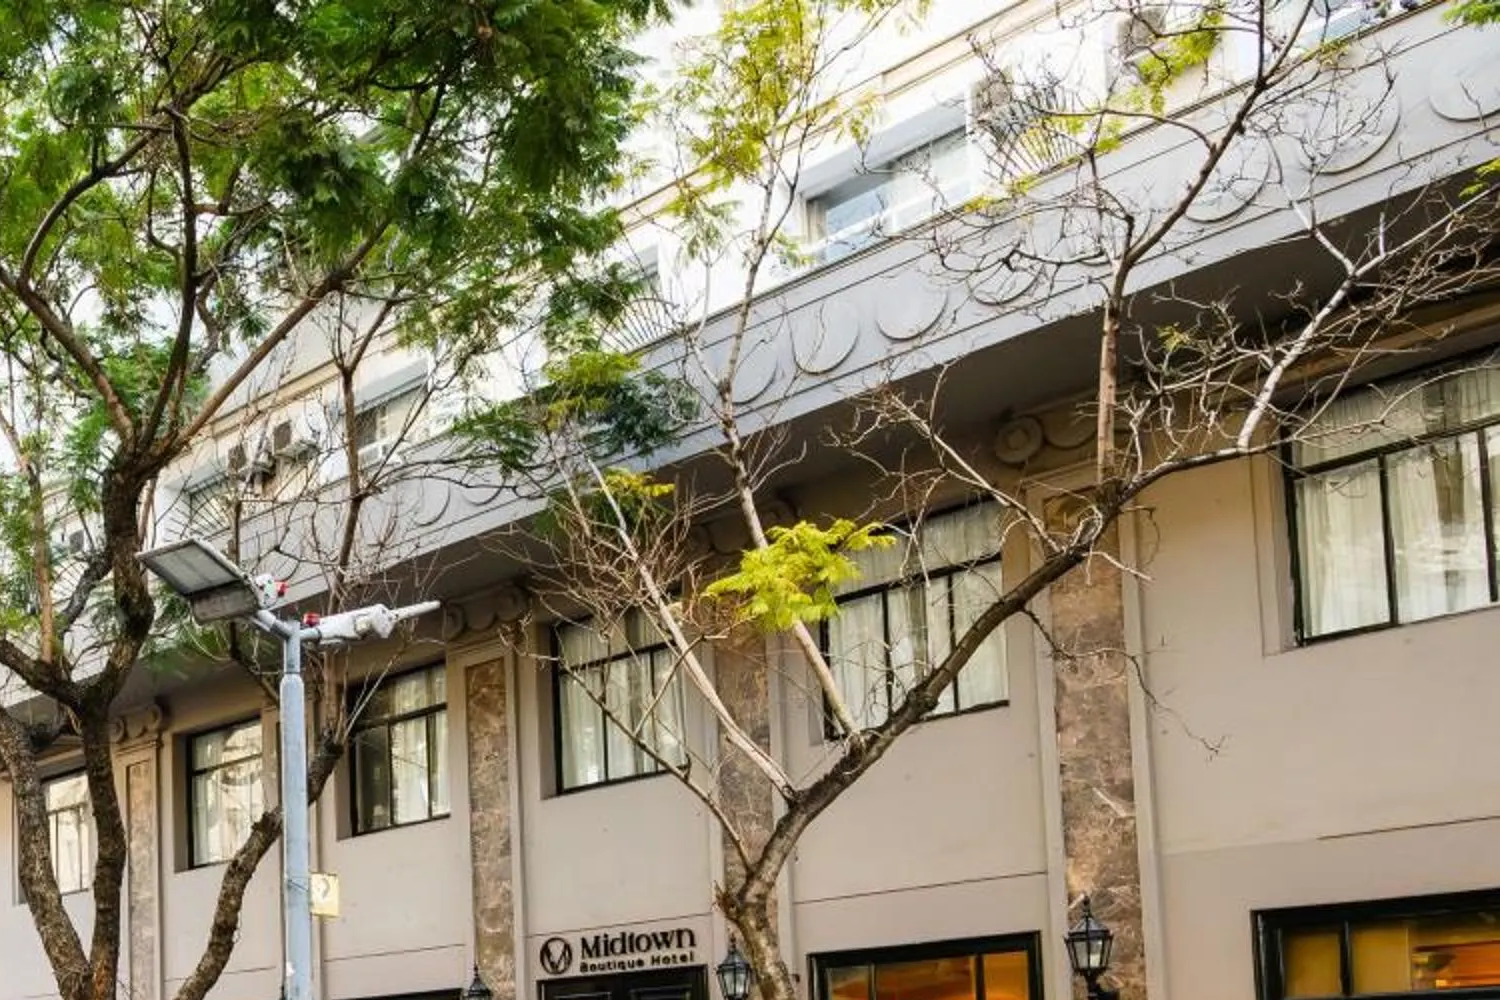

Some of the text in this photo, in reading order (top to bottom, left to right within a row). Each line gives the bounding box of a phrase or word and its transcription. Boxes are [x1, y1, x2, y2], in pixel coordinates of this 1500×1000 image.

[580, 928, 696, 959] Midtown
[579, 950, 695, 973] Boutique Hotel
